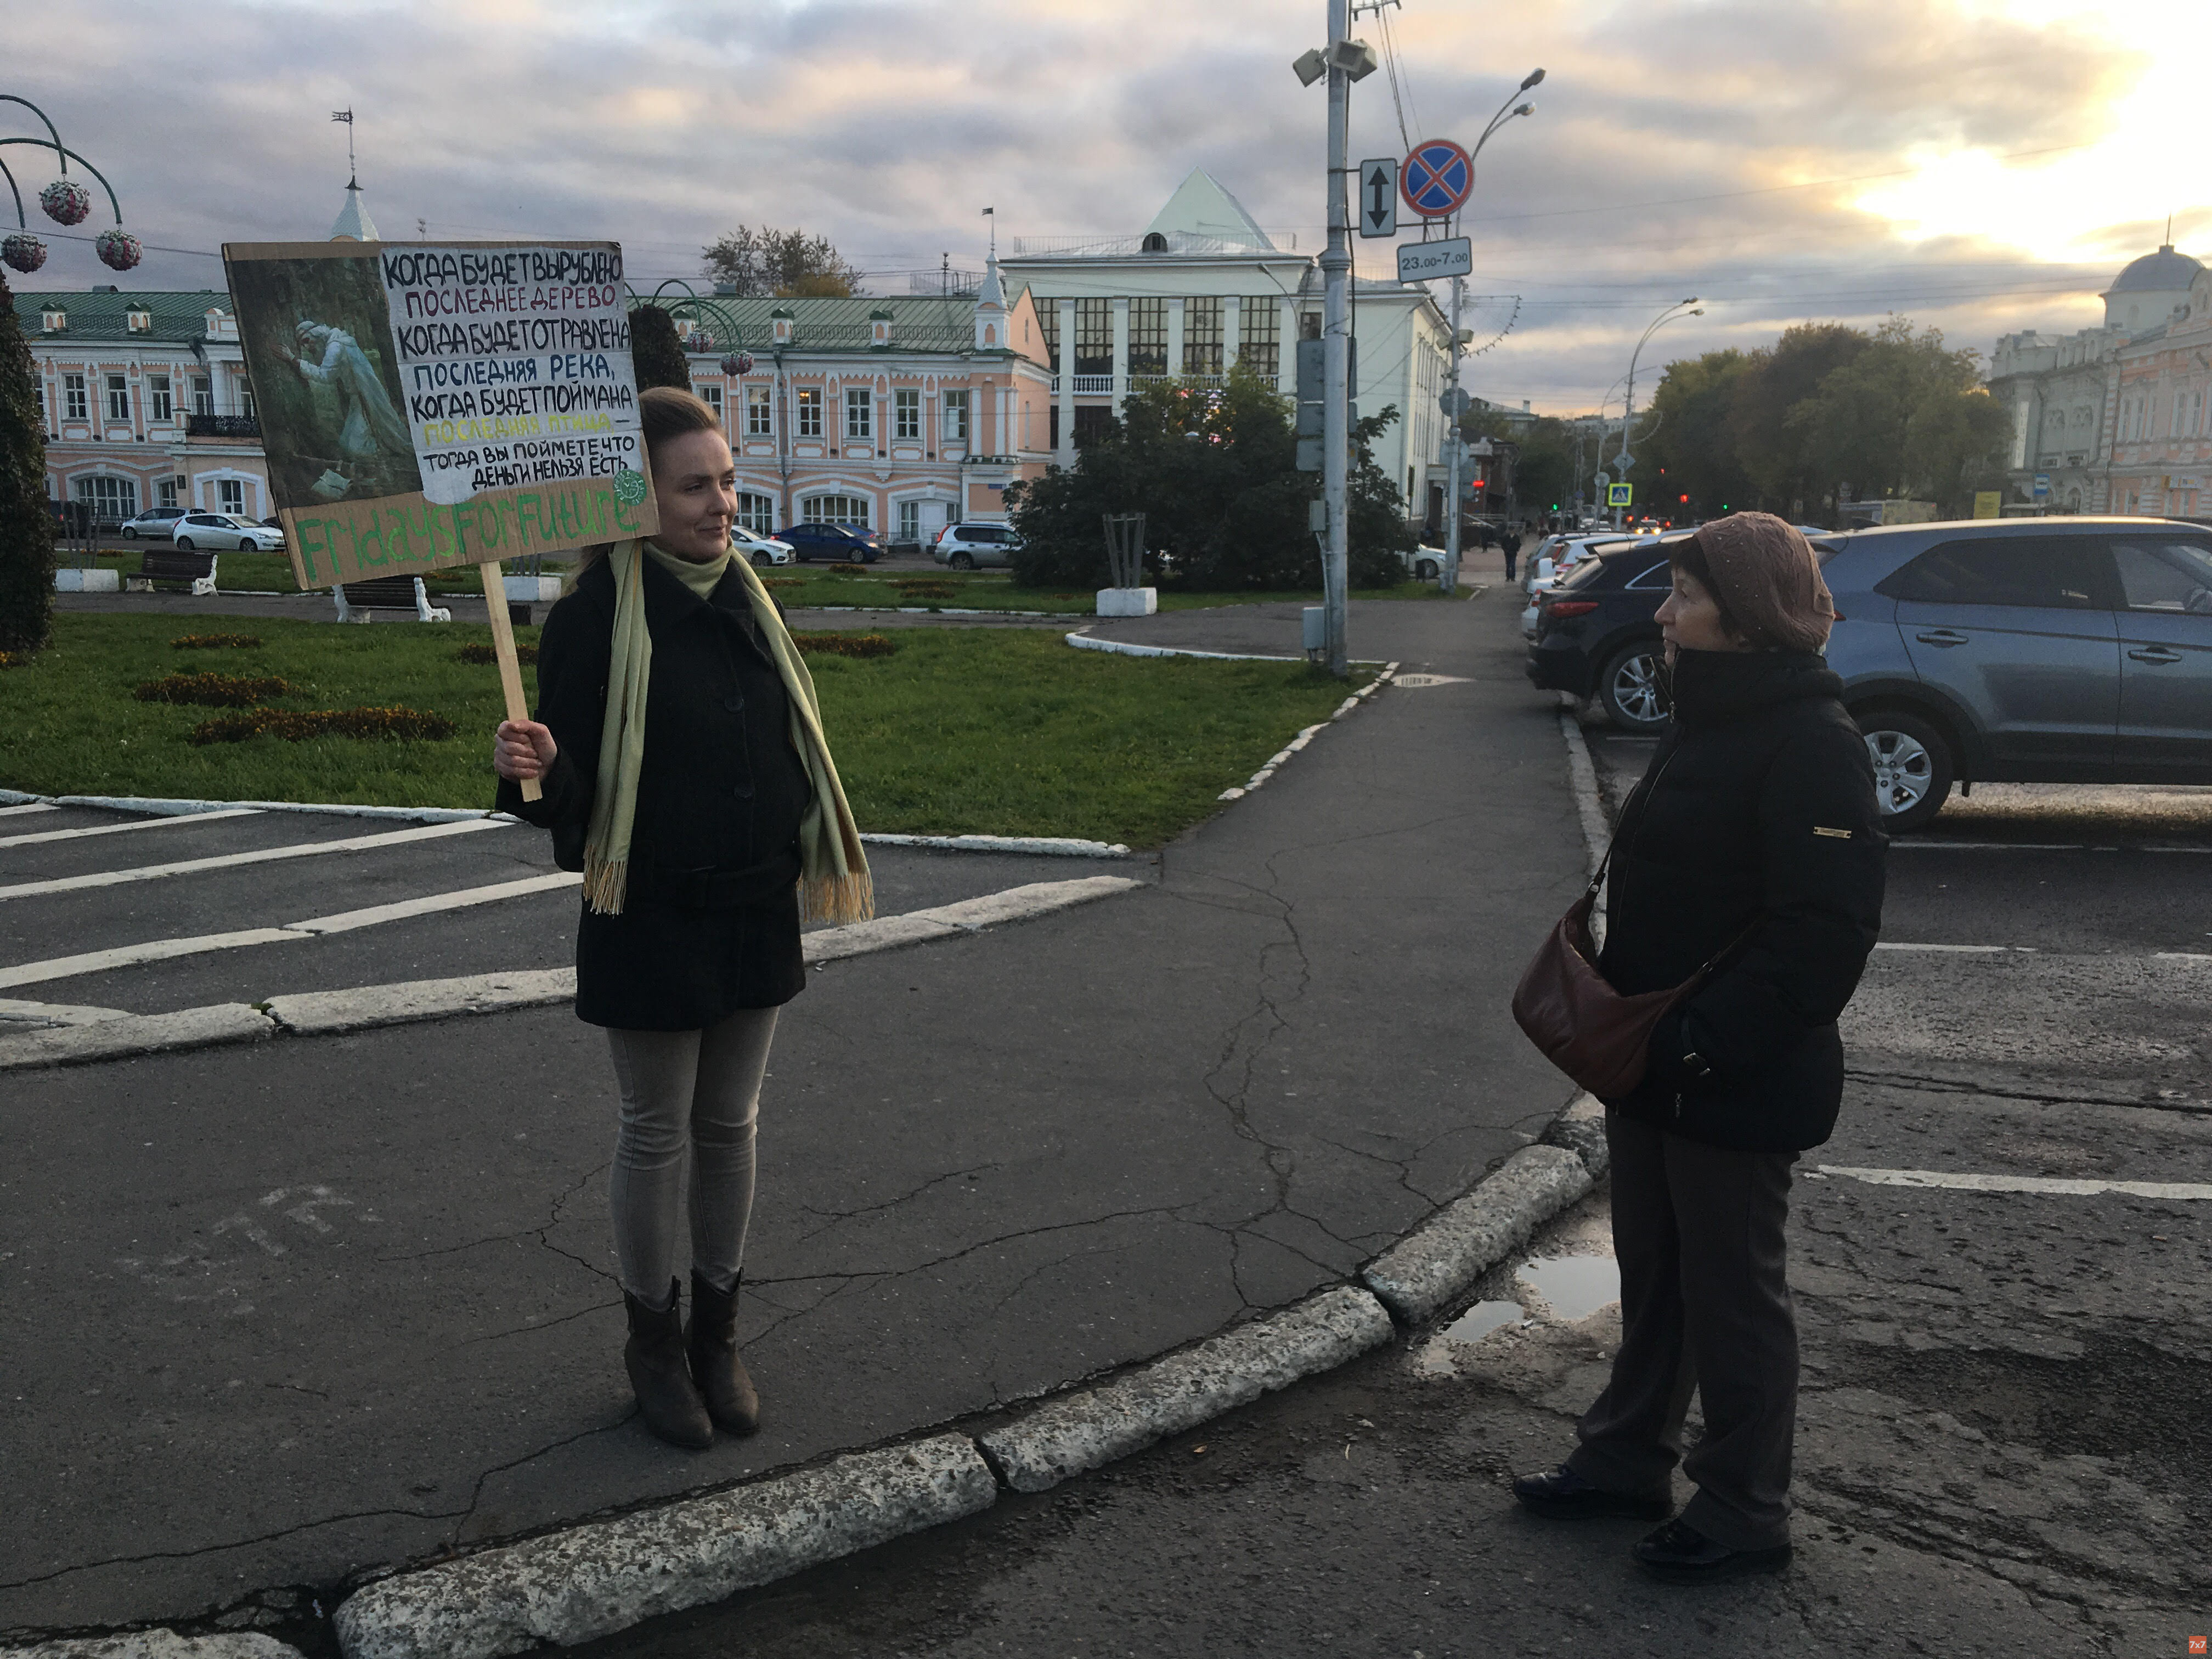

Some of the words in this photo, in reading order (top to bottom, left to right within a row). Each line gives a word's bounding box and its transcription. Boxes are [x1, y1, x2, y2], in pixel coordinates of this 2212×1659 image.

[382, 252, 459, 289] КОГДА
[461, 253, 529, 286] БУДЕТ
[532, 251, 620, 286] ВЫРУБЛЕНО
[1402, 252, 1468, 270] 23.00-7.00
[405, 286, 527, 318] ПОСЛЕДНЕЕ
[531, 285, 619, 310] ДЕРЕВО,
[398, 323, 468, 359] КОГДА
[469, 320, 531, 354] БУДЕТ
[532, 318, 630, 350] ОТРАВЛЕНА
[414, 358, 537, 391] ПОСЛЕДНЯЯ
[550, 353, 615, 381] РЕКА,
[411, 391, 477, 424] КОГДА
[480, 386, 541, 416] БУДЕТ
[544, 380, 633, 413] ПОЙМАНА
[424, 415, 540, 446] ПОСЛЕДНЯЯ
[423, 450, 479, 472] ТОГДА
[483, 446, 509, 464] ВЫ
[602, 436, 635, 452] ЧТО
[472, 463, 531, 490] ДЕНЬГИ
[533, 456, 584, 482] НЕЛЬЗЯ
[590, 455, 628, 476] ЕСТЬ
